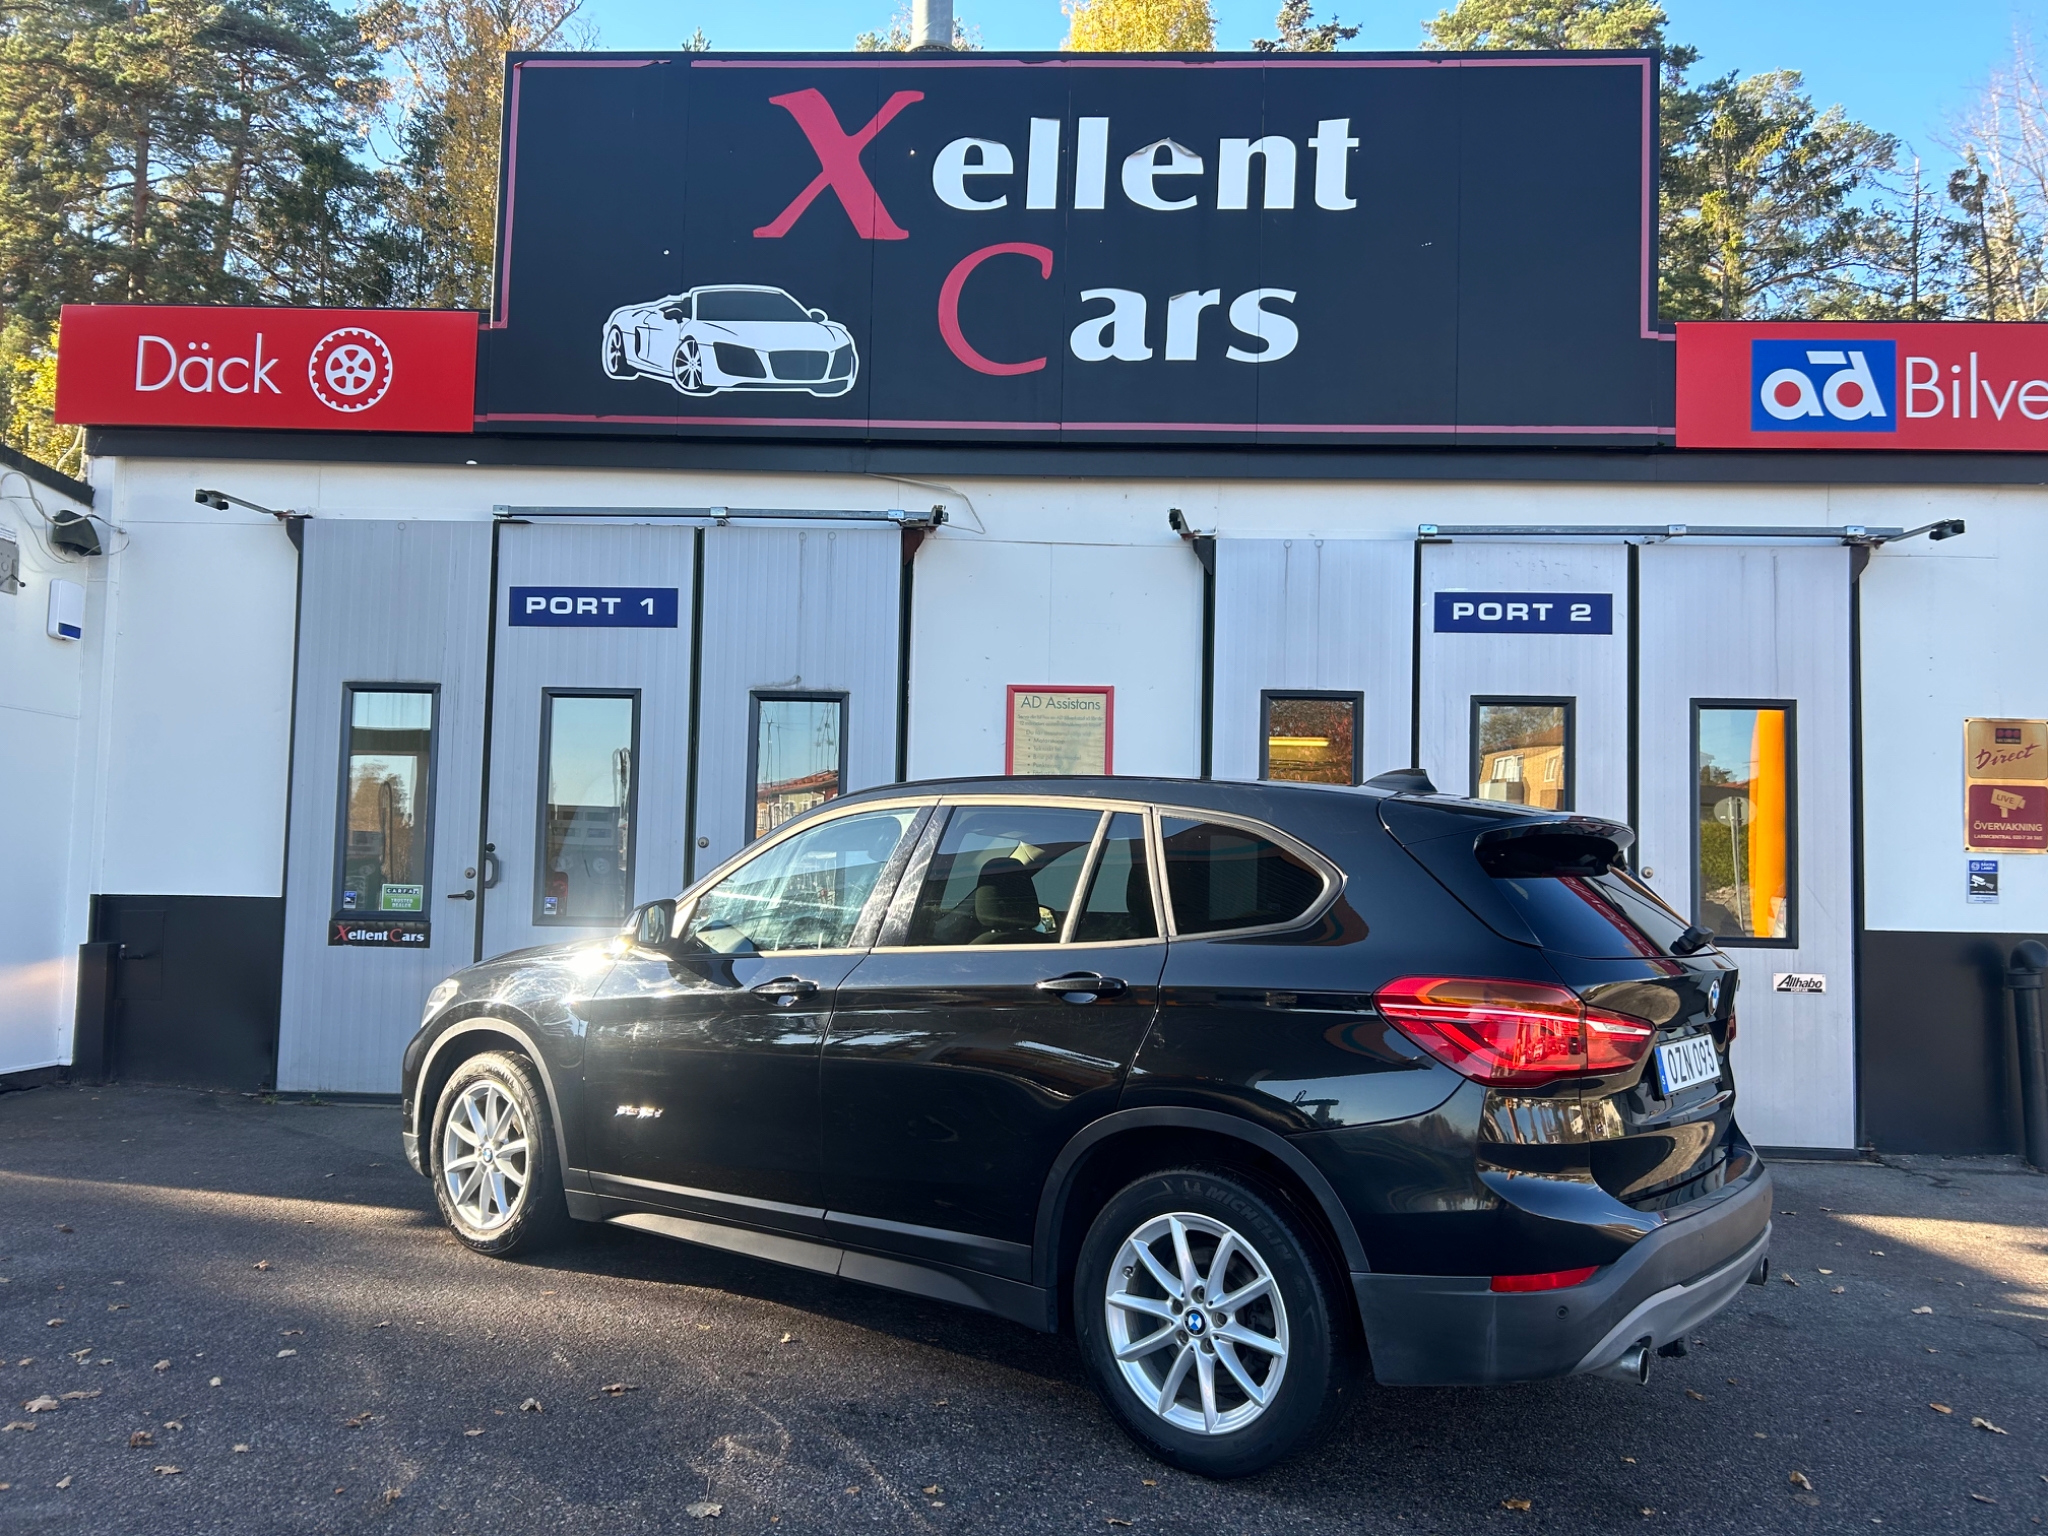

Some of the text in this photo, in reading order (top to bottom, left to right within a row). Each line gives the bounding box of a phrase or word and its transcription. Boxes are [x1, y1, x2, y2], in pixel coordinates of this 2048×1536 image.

[753, 87, 1361, 240] Xellent
[938, 242, 1299, 376] Cars
[135, 332, 282, 394] Däck
[1905, 351, 2048, 421] Bilve
[526, 596, 654, 616] PORT 1
[1453, 602, 1592, 622] PORT 2
[1020, 695, 1101, 710] AD Assistans
[1974, 743, 2042, 770] Direct
[1996, 793, 2016, 805] LIVE
[1973, 820, 2043, 832] ÖVERVAKNING
[1777, 974, 1823, 988] Allhabo
[1667, 1039, 1715, 1084] OZN 093
[1206, 1185, 1293, 1261] MICHELIN
